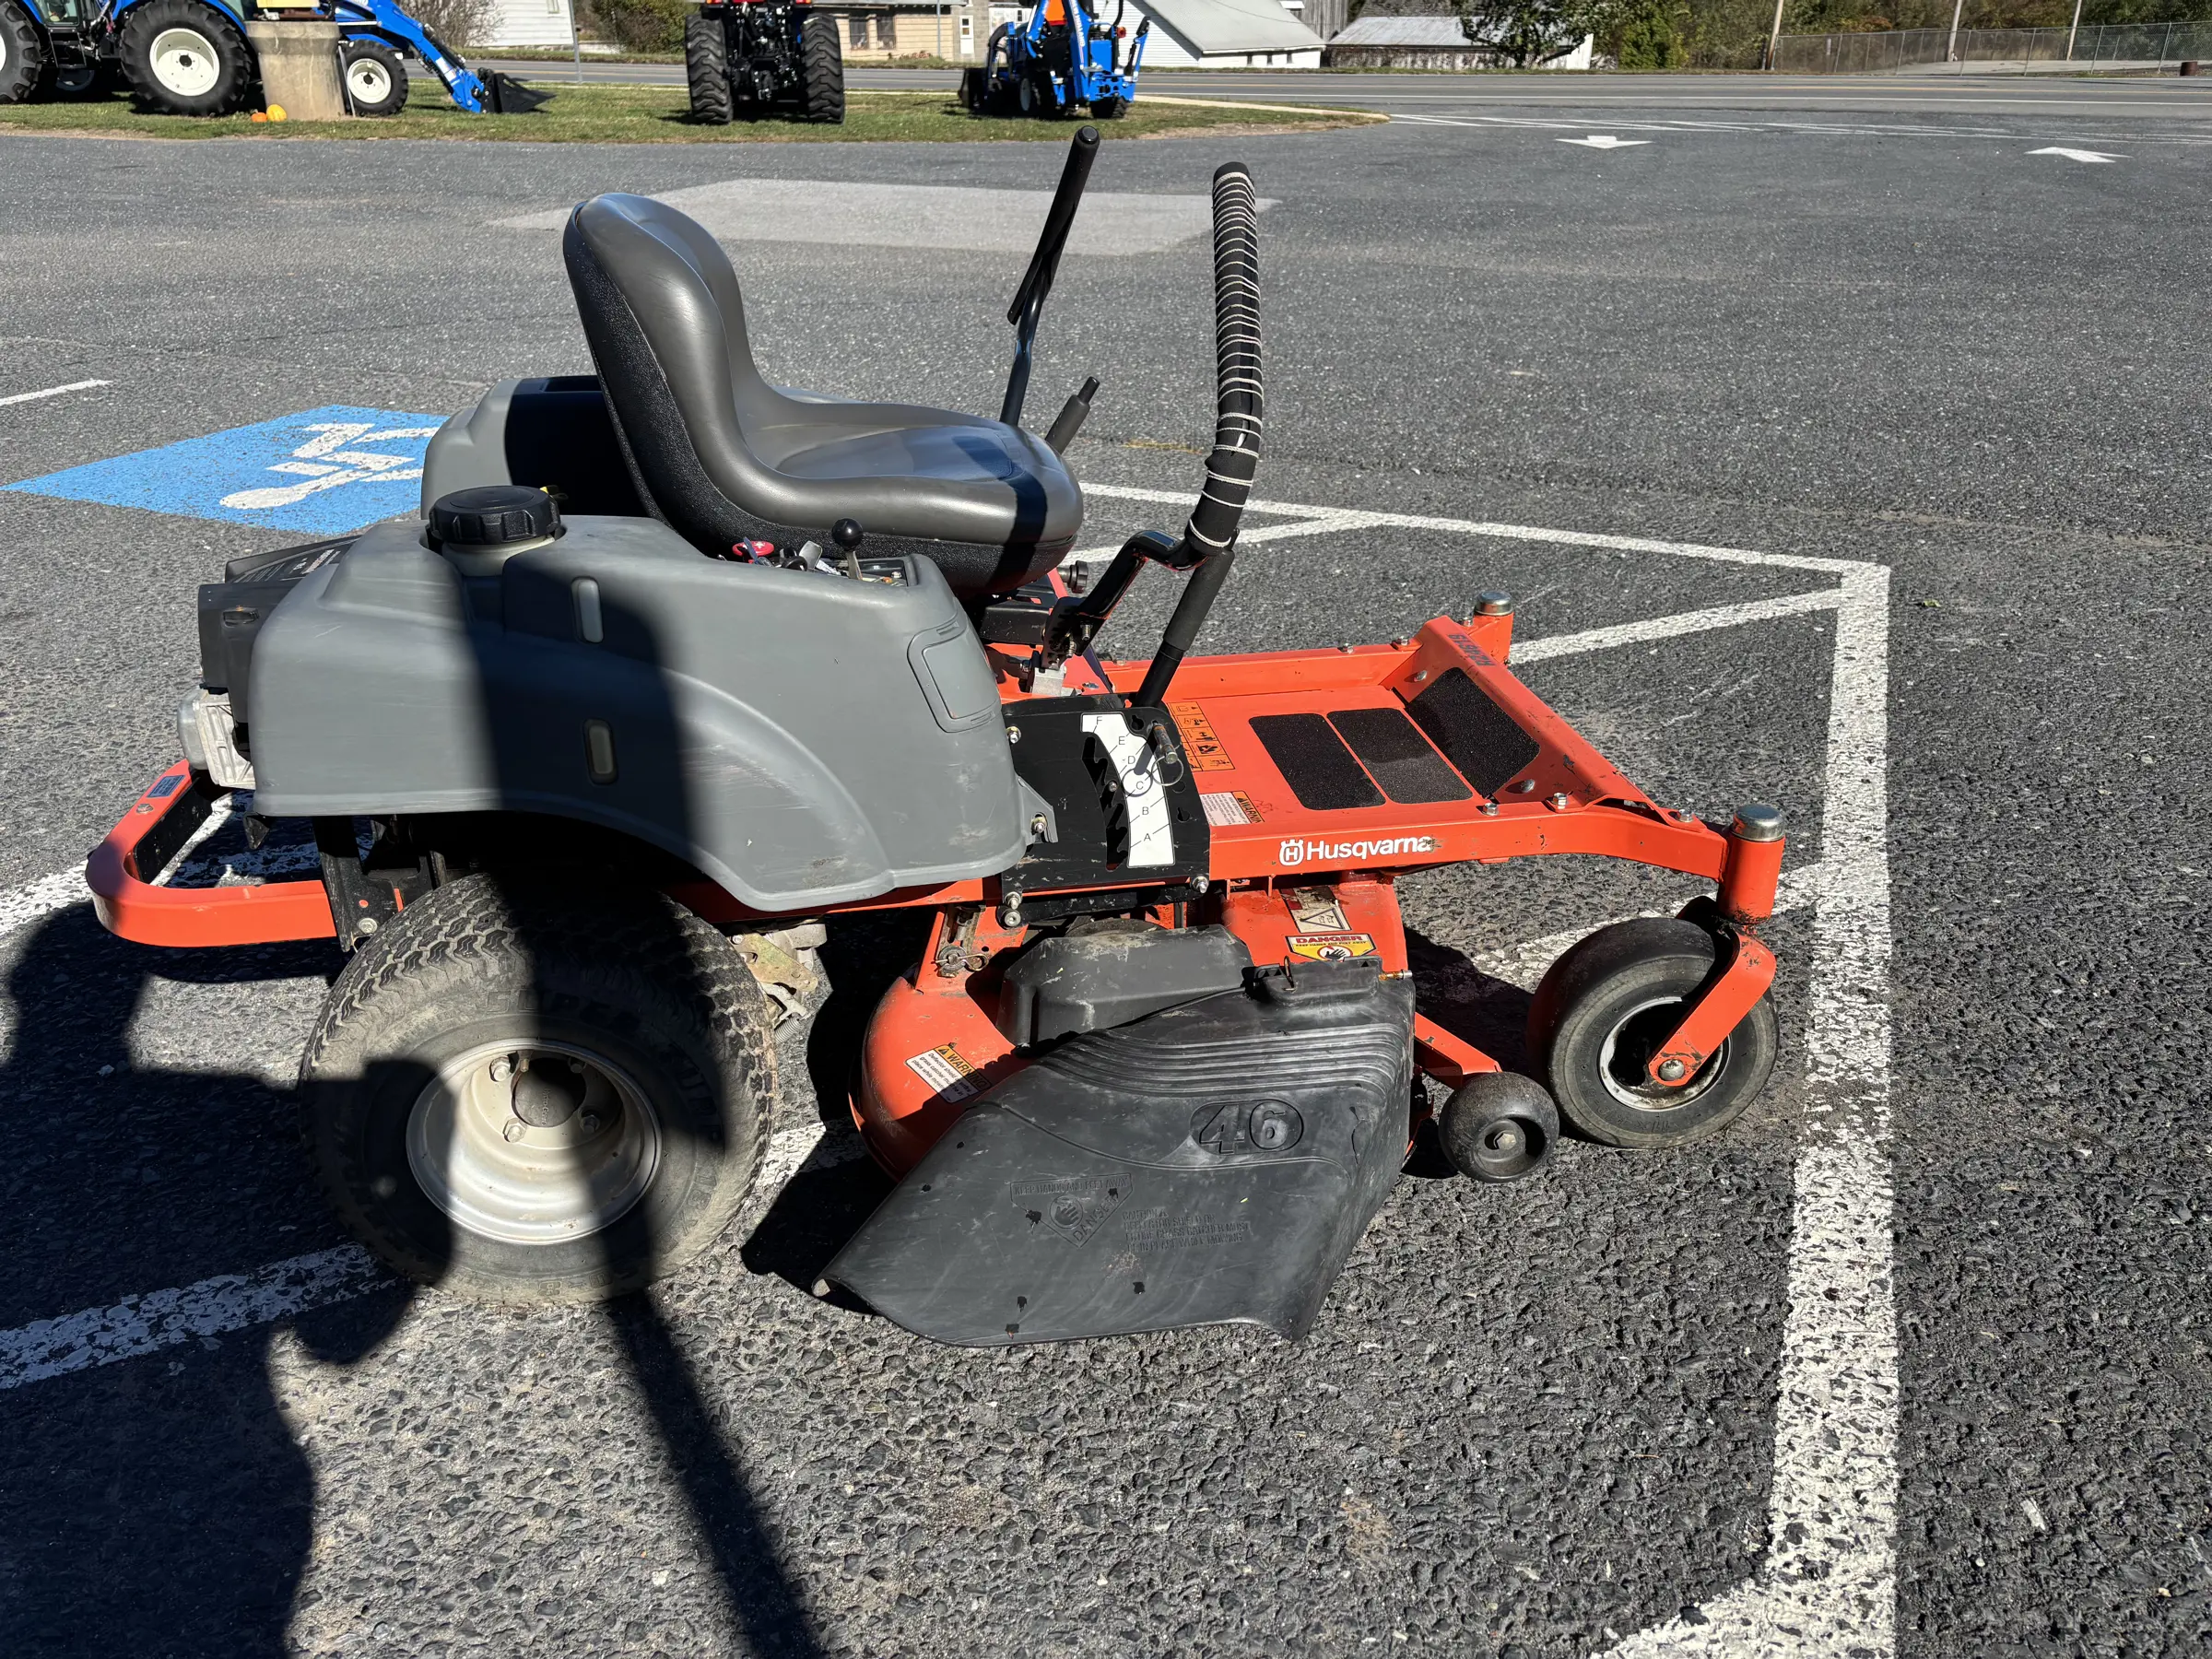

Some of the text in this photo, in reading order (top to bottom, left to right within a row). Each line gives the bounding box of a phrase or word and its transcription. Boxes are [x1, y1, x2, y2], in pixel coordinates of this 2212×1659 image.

[1447, 634, 1497, 666] RZ4619
[1096, 717, 1103, 725] F
[1118, 736, 1125, 745] E
[1128, 756, 1136, 765] D
[1135, 781, 1144, 790] C
[1142, 806, 1149, 815] B
[1143, 833, 1152, 841] A
[1306, 836, 1433, 861] Husqvarna
[947, 1053, 988, 1088] WARNING
[1198, 1100, 1292, 1154] 46
